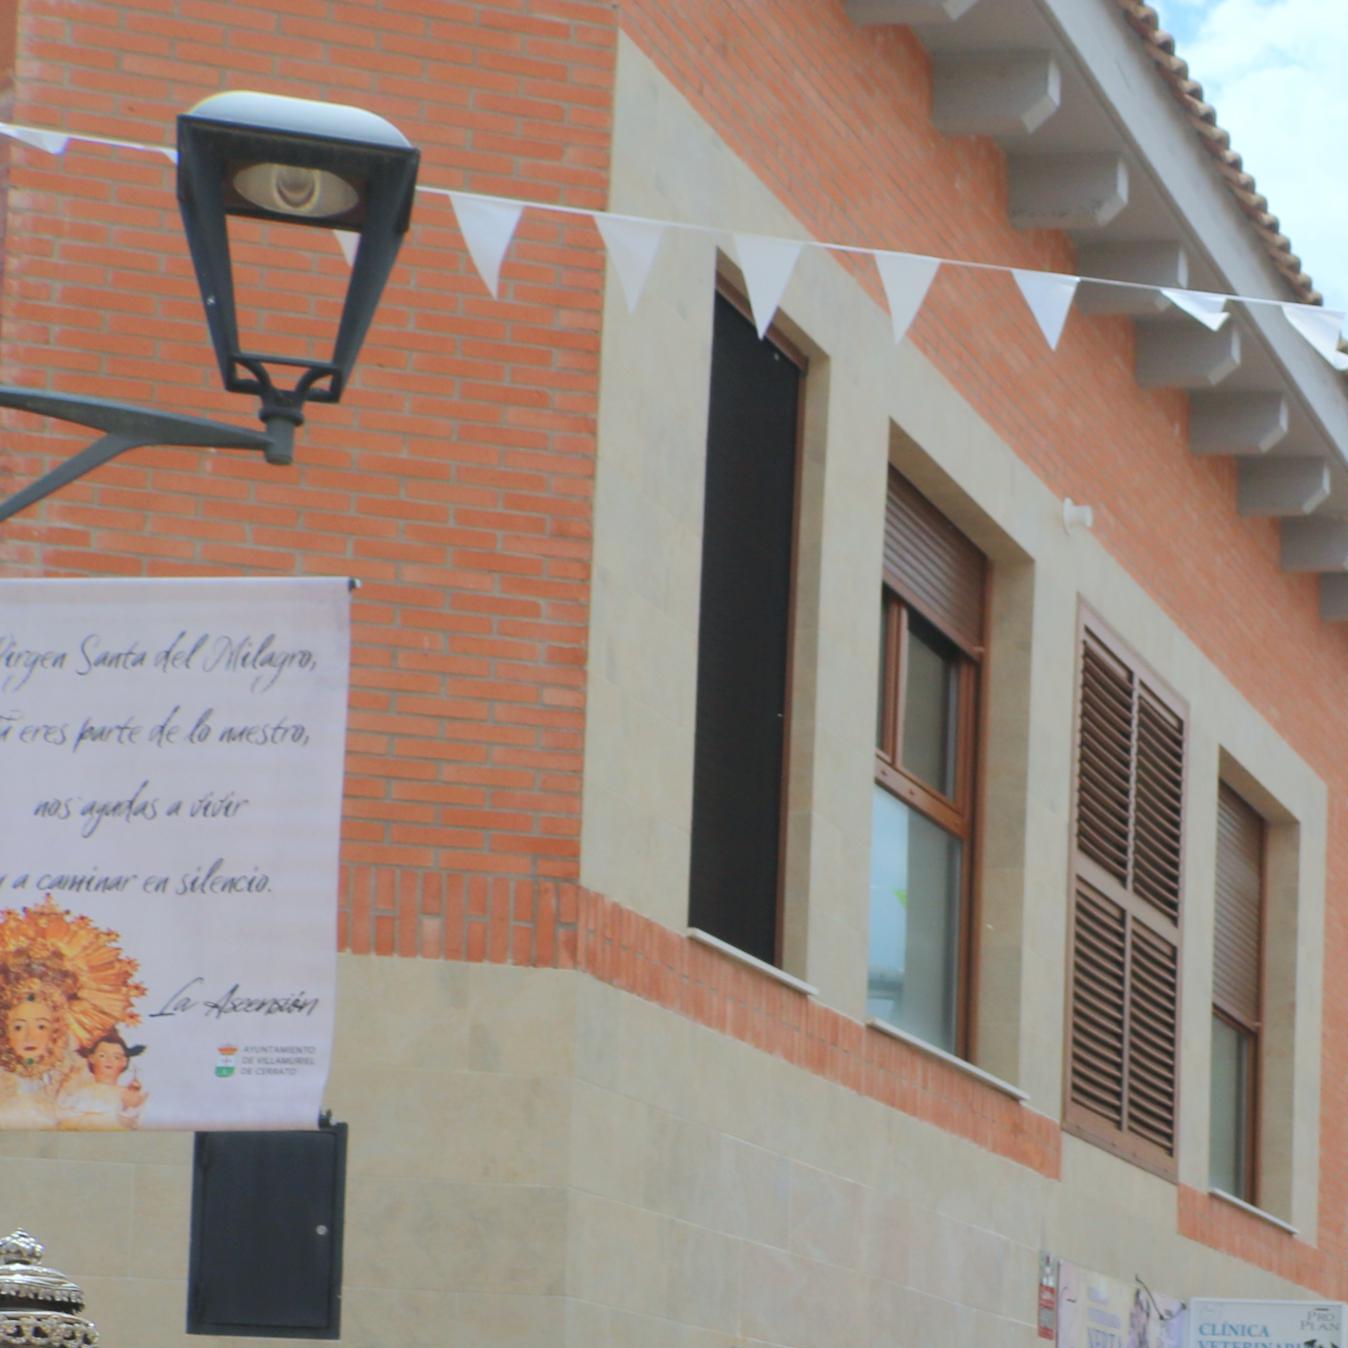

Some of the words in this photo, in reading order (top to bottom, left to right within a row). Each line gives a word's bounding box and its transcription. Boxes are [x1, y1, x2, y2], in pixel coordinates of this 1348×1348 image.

[76, 633, 146, 676] Santa
[153, 631, 209, 673] del
[202, 633, 317, 693] Milagro,
[19, 723, 67, 746] eres
[73, 716, 143, 754] parte
[148, 705, 182, 748] de
[187, 708, 213, 745] lo
[219, 717, 310, 747] nuestro,
[33, 797, 72, 820] nos
[80, 780, 160, 839] ayudas
[166, 798, 183, 818] a
[189, 791, 249, 819] vivir
[12, 872, 28, 890] a
[36, 866, 137, 893] caminar
[143, 875, 169, 895] en
[175, 858, 272, 896] silencio.
[148, 976, 204, 1018] La
[1198, 1321, 1270, 1339] CLÍNICA
[1300, 1320, 1342, 1332] PLAN
[1307, 1310, 1336, 1322] PRO
